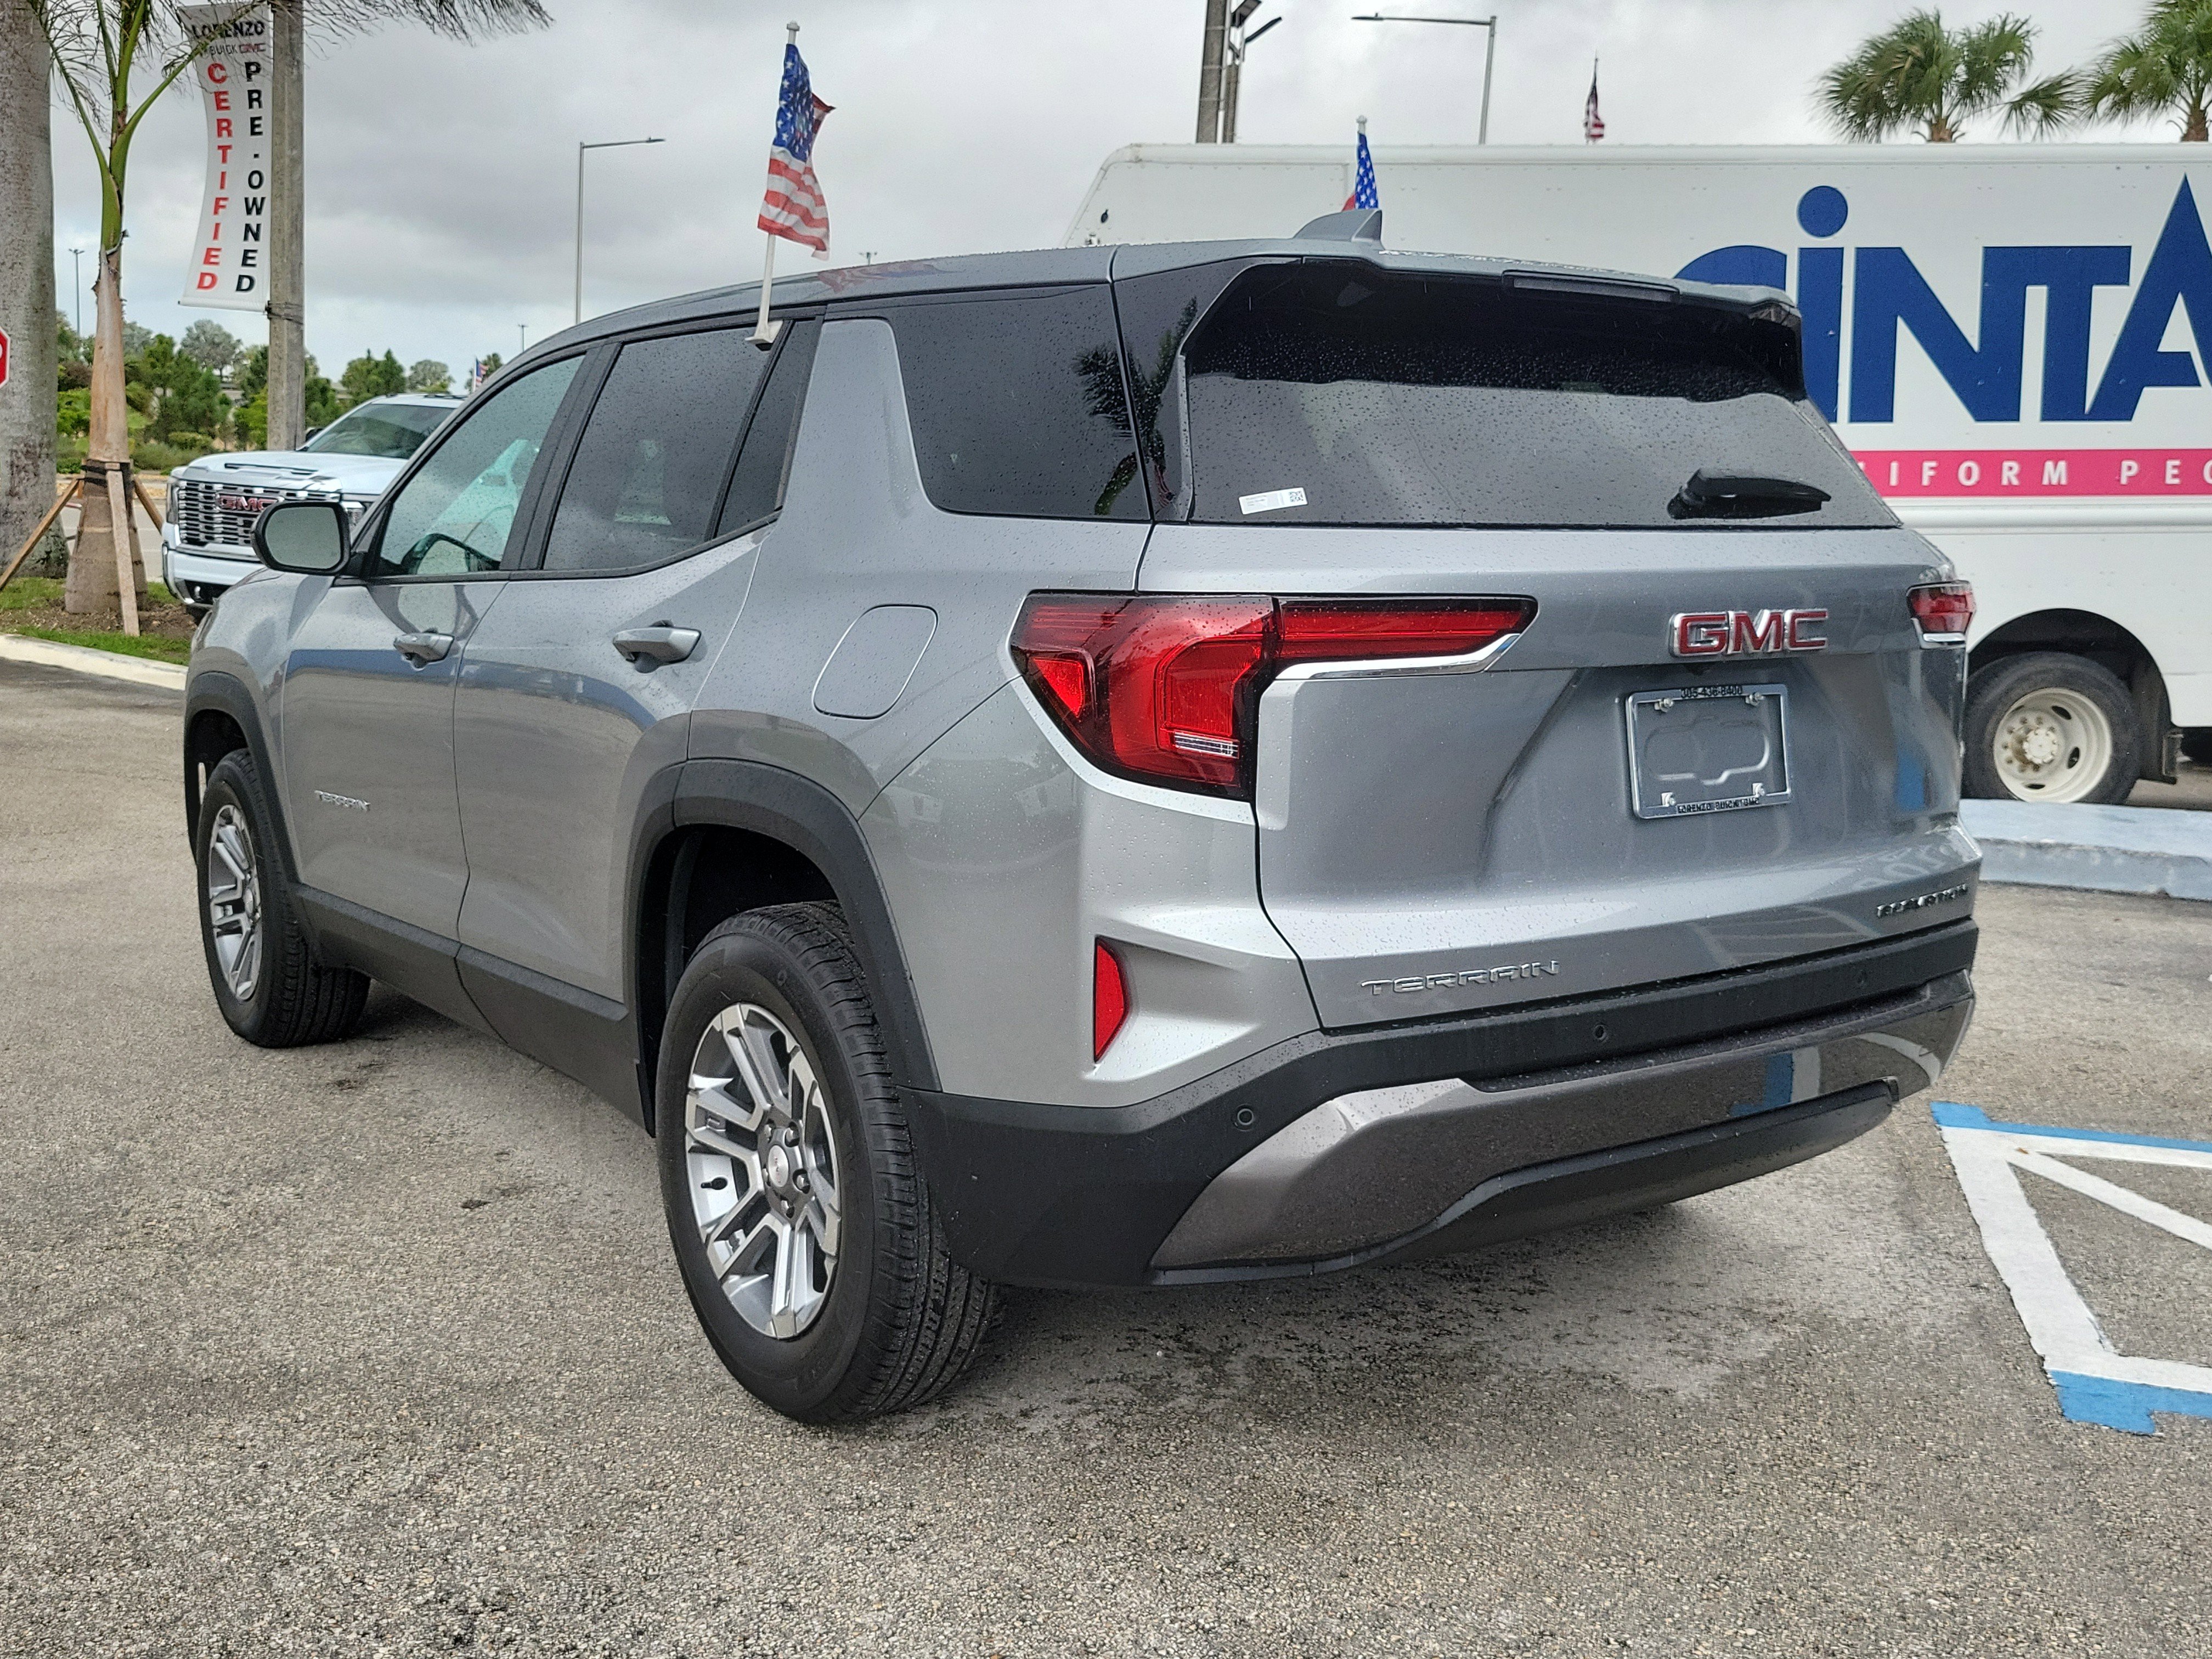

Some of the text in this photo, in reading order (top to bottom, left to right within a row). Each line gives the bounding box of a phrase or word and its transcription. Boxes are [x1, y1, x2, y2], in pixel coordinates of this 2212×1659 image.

[196, 63, 234, 291] CERTIFIED
[235, 61, 266, 292] PRE-OWNED
[1857, 460, 2068, 487] IFORM
[1669, 608, 1829, 657] GMC
[314, 789, 371, 812] TERRAIN
[1361, 960, 1560, 995] TERRAIN
